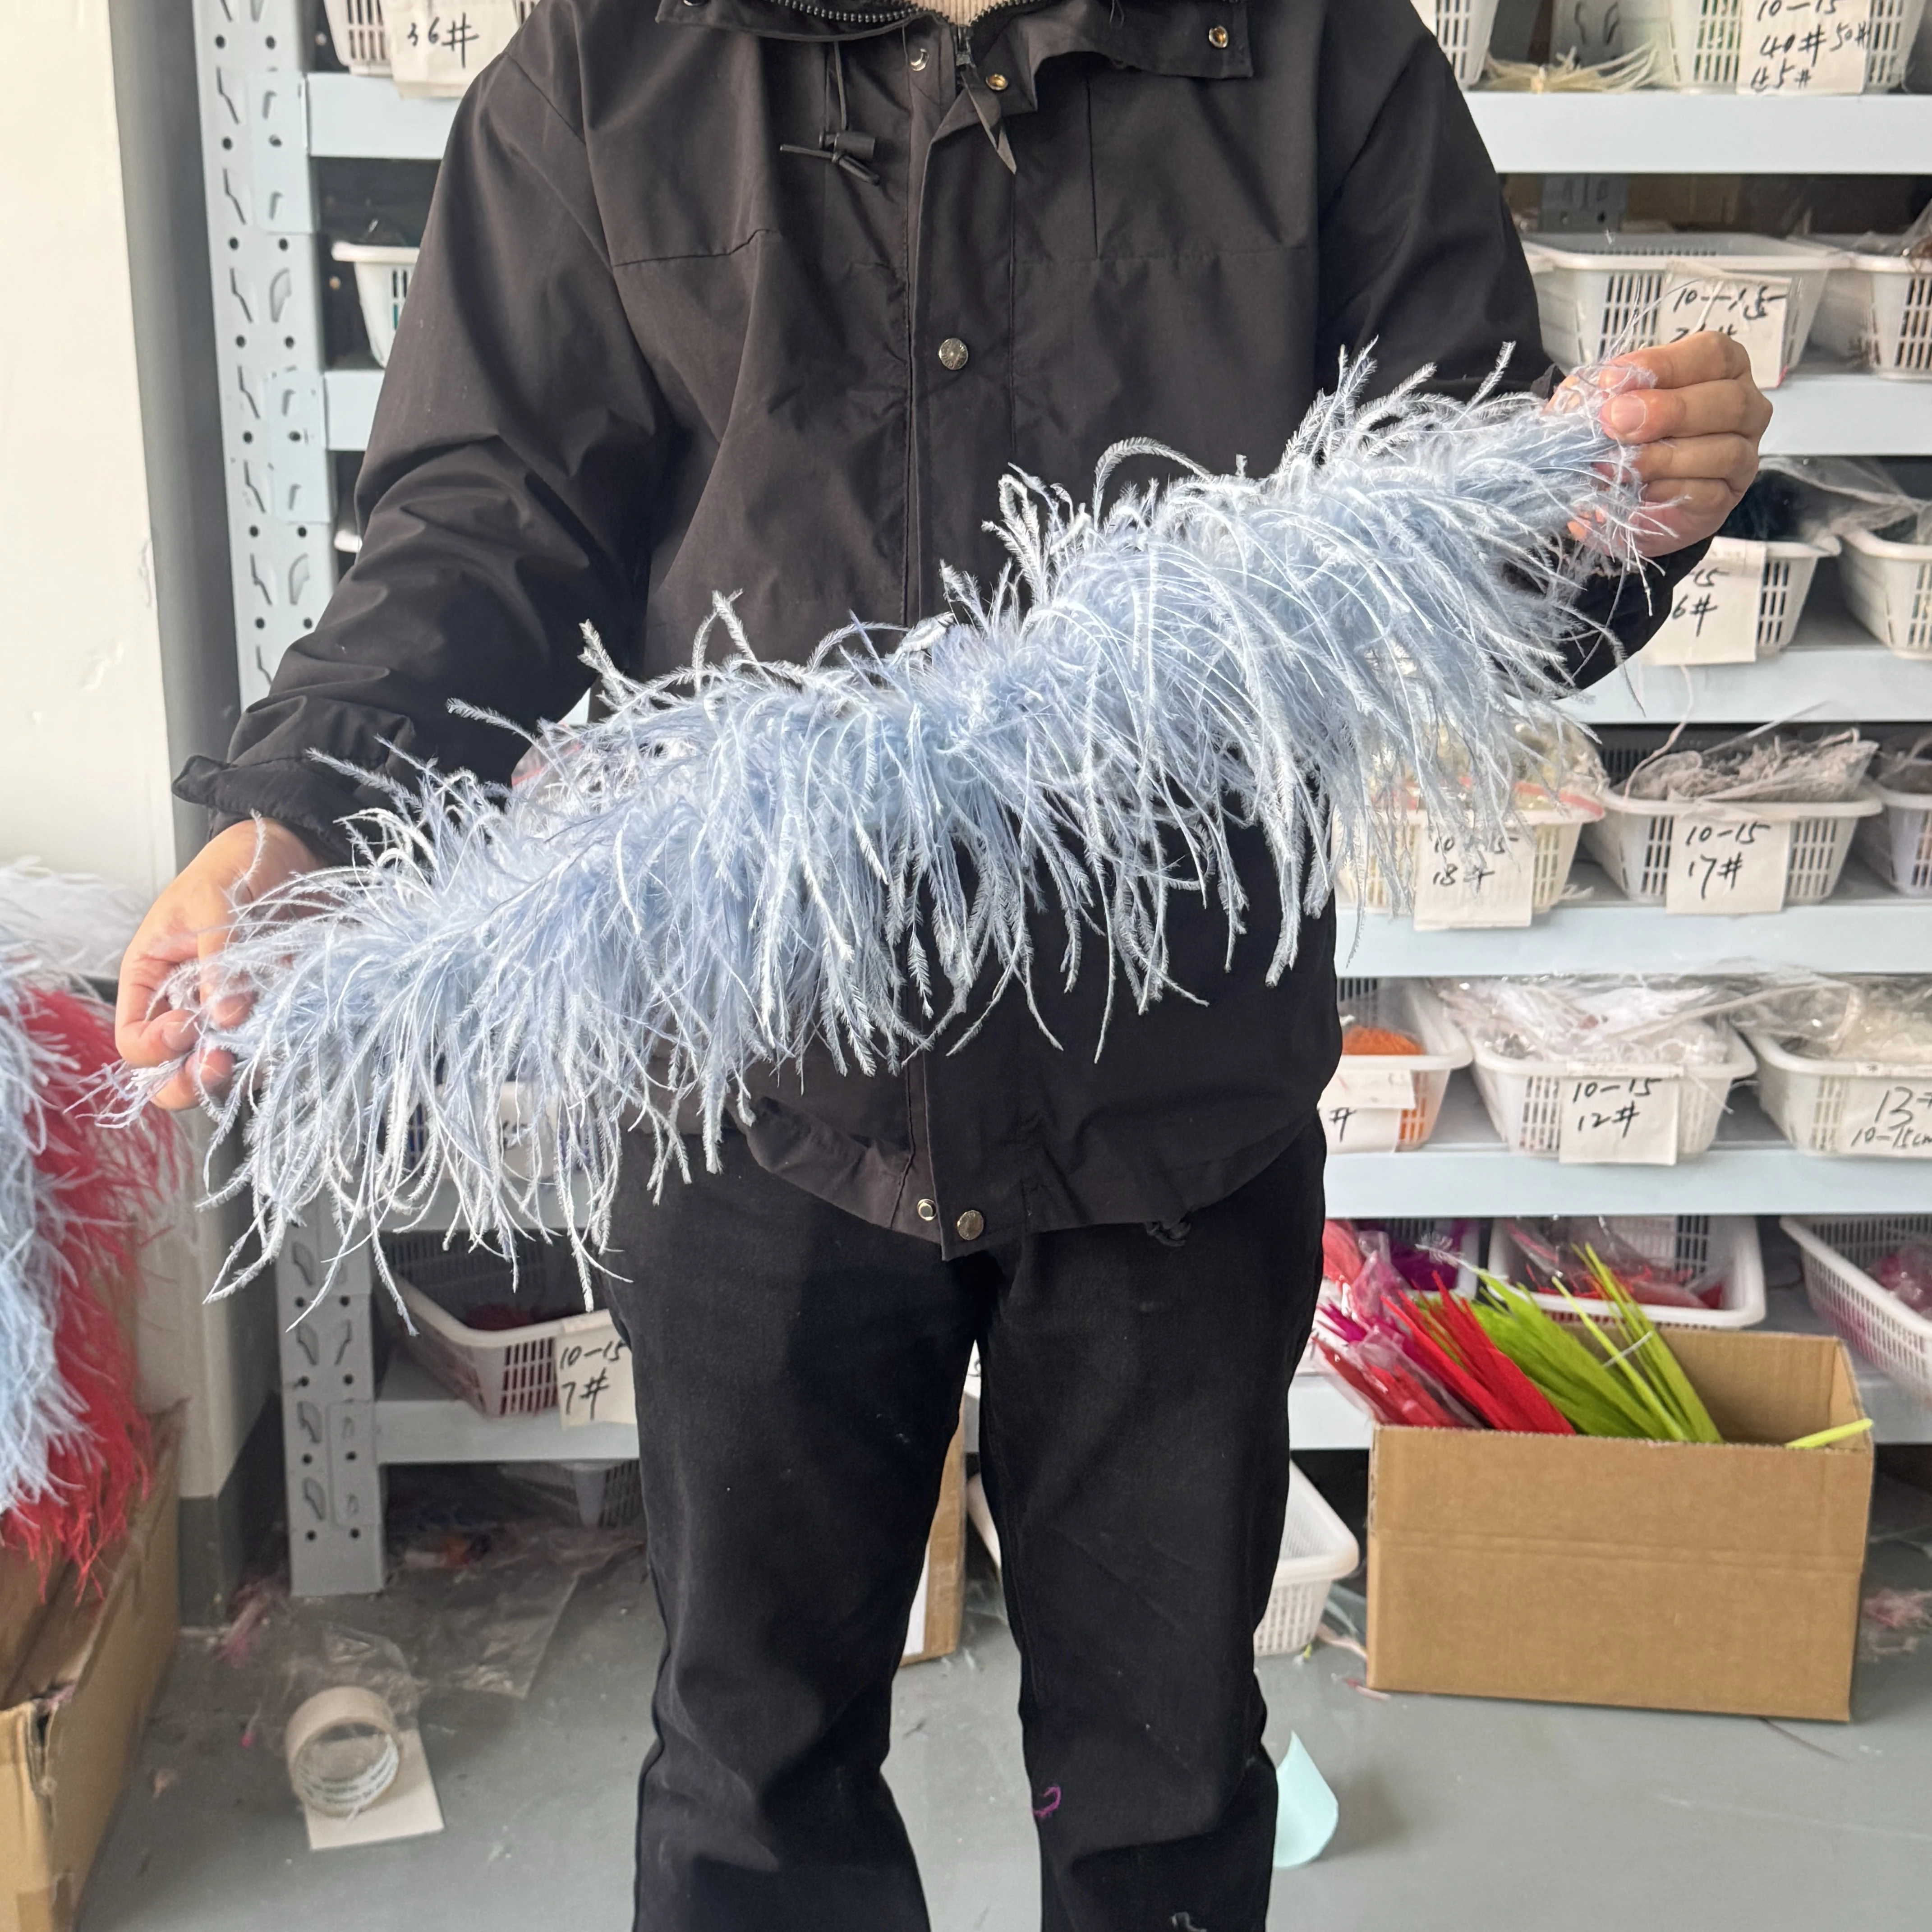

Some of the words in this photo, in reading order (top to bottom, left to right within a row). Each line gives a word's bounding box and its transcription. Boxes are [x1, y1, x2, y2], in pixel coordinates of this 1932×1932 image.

[1685, 820, 1771, 846] 10-15
[1688, 851, 1743, 900] 17#
[1573, 1077, 1663, 1103] 10-15
[1578, 1100, 1640, 1138] 12#
[560, 1340, 628, 1370] 10-15
[561, 1367, 610, 1421] 7#
